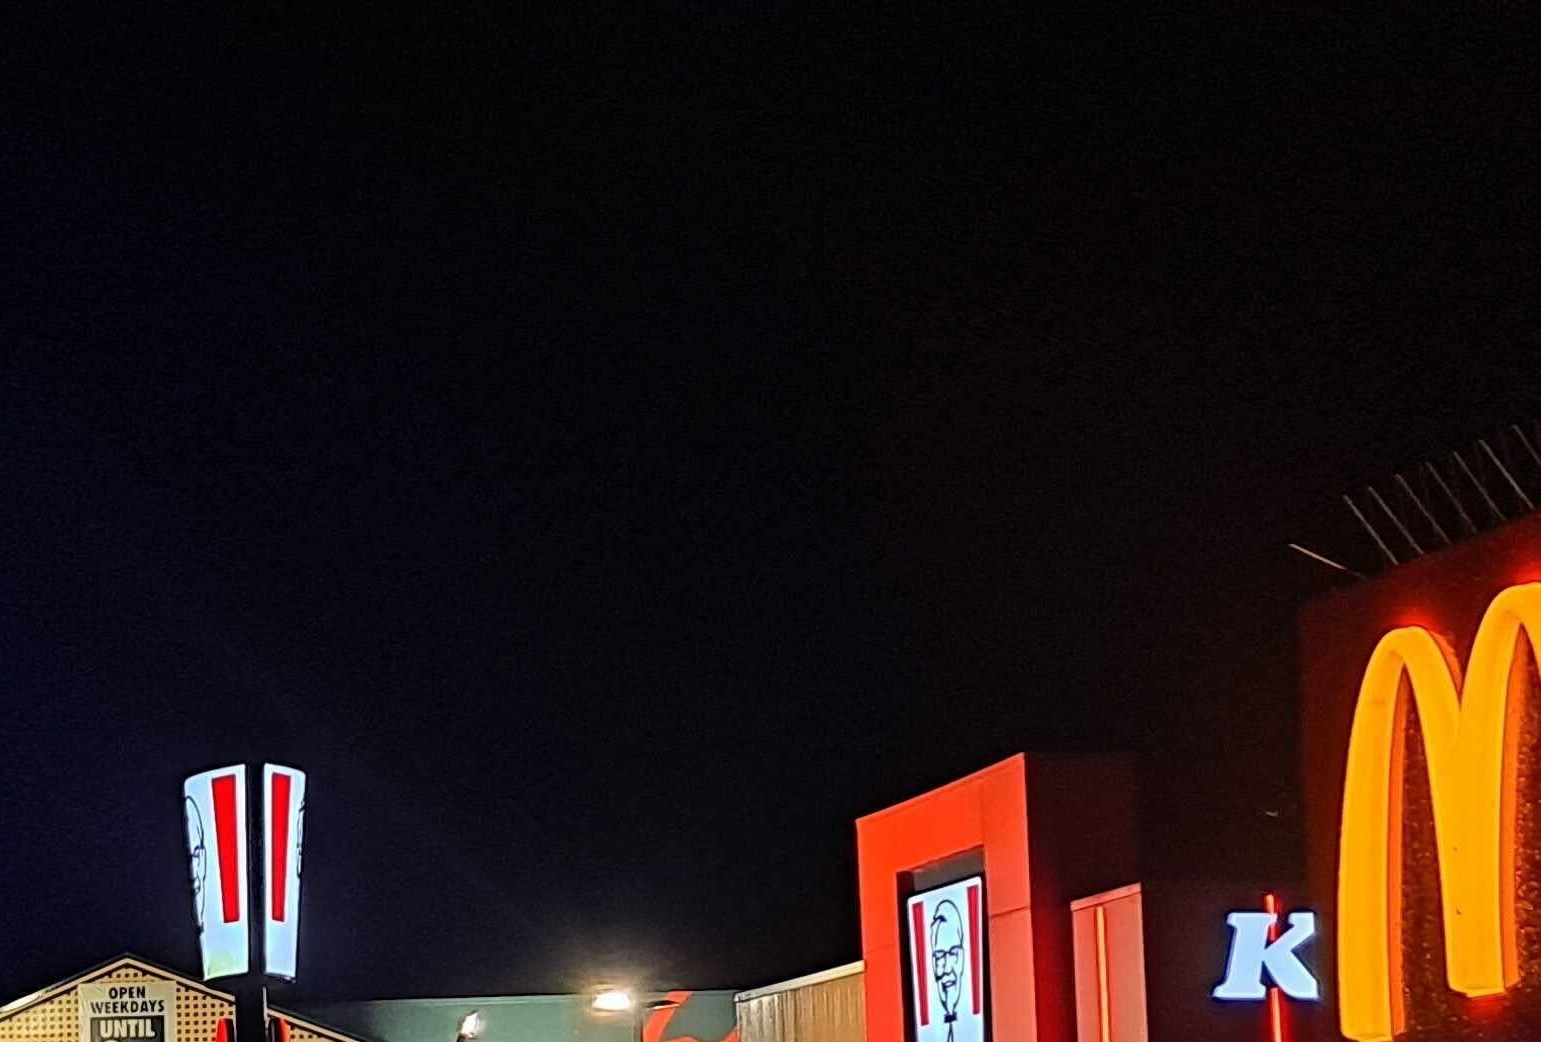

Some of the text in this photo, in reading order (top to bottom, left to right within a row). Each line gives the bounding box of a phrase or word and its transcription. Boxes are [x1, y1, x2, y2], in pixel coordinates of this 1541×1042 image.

[1211, 911, 1319, 999] K
[108, 985, 146, 999] OPEN
[90, 1000, 165, 1014] WEEKDAYS
[100, 1018, 156, 1038] UNTIL
